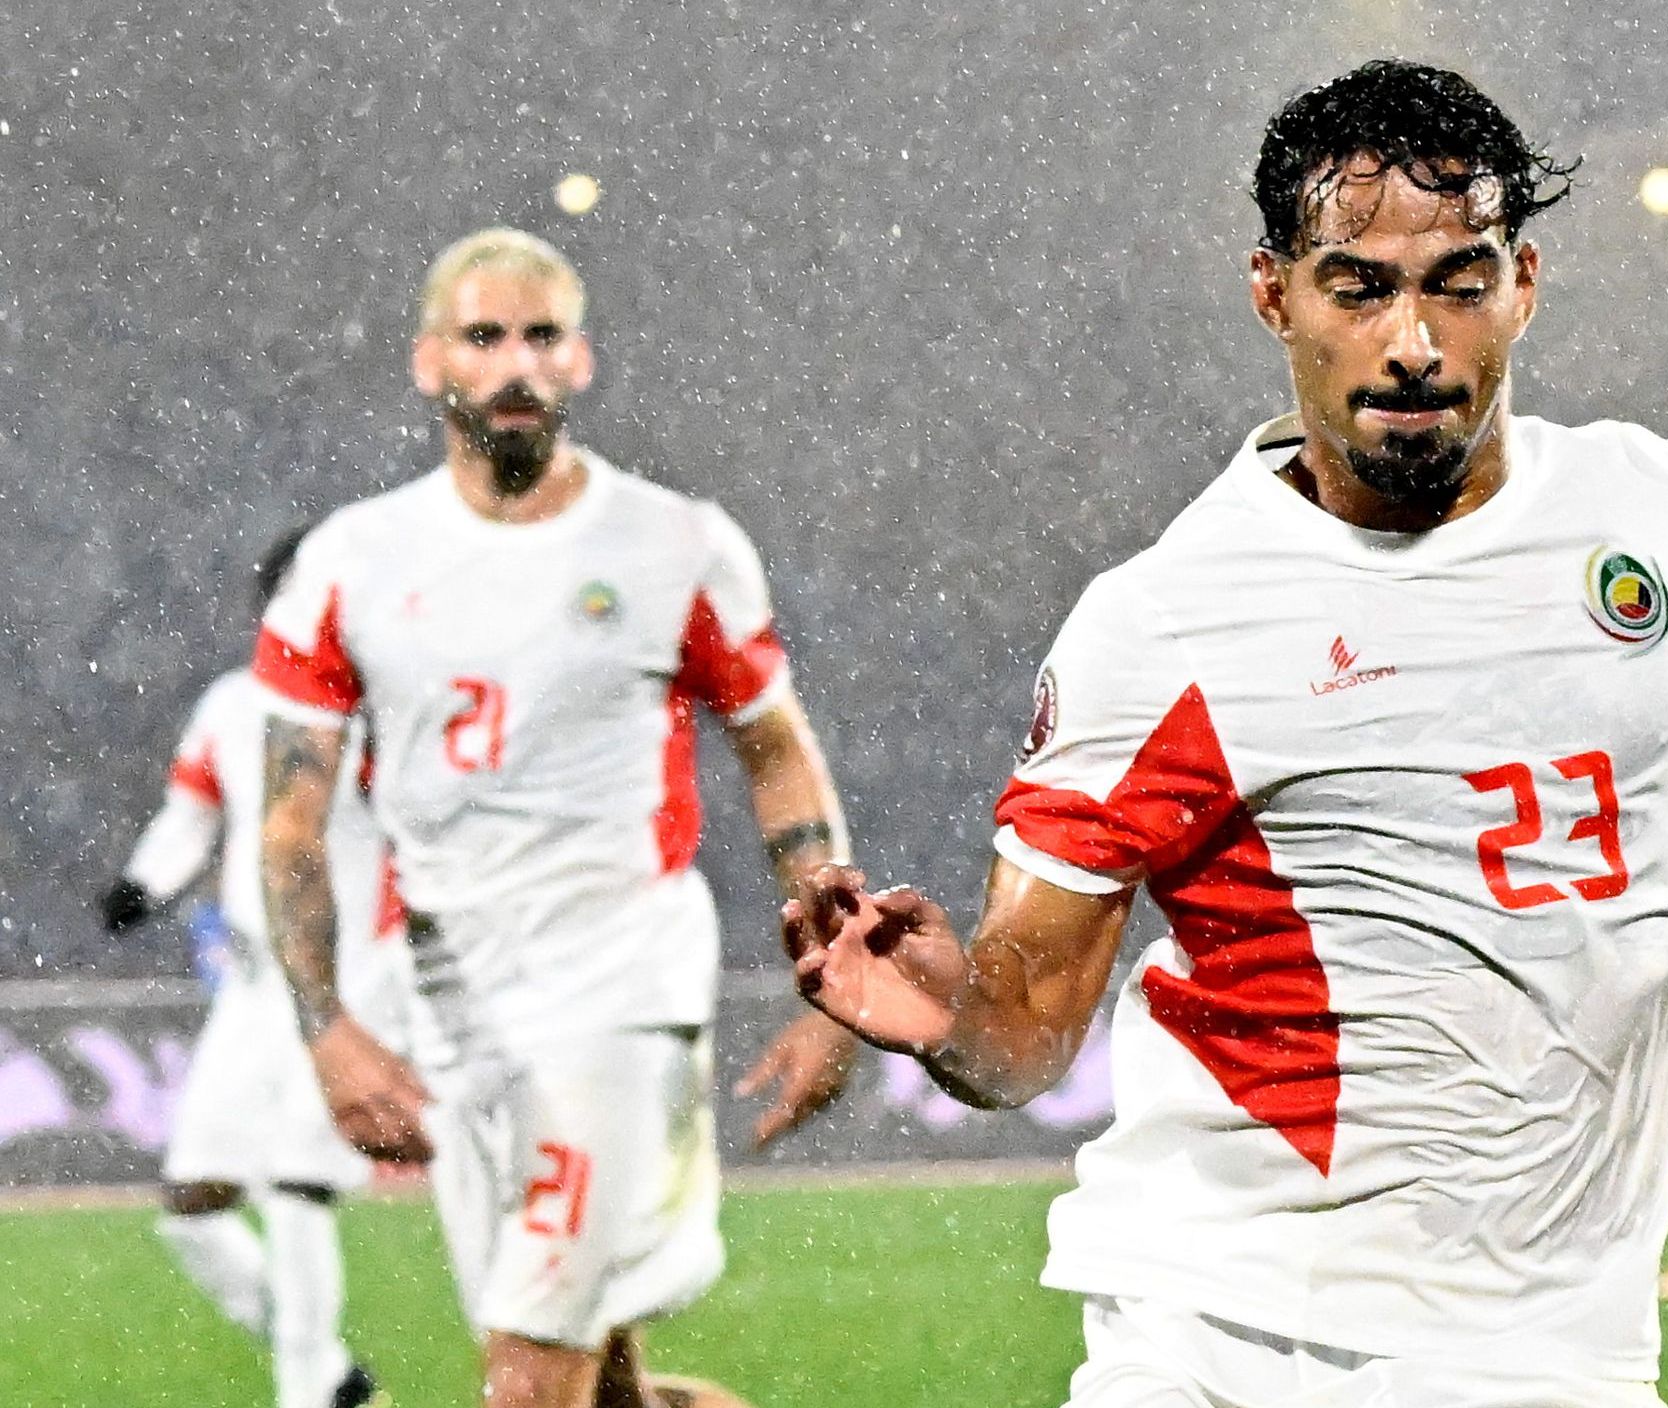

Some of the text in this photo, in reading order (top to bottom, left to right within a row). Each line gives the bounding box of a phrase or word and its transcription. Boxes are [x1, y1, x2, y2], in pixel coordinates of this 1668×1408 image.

[442, 676, 506, 774] 21
[1309, 666, 1396, 696] Lacatoni
[1460, 749, 1628, 910] 23
[523, 1142, 592, 1238] 21
